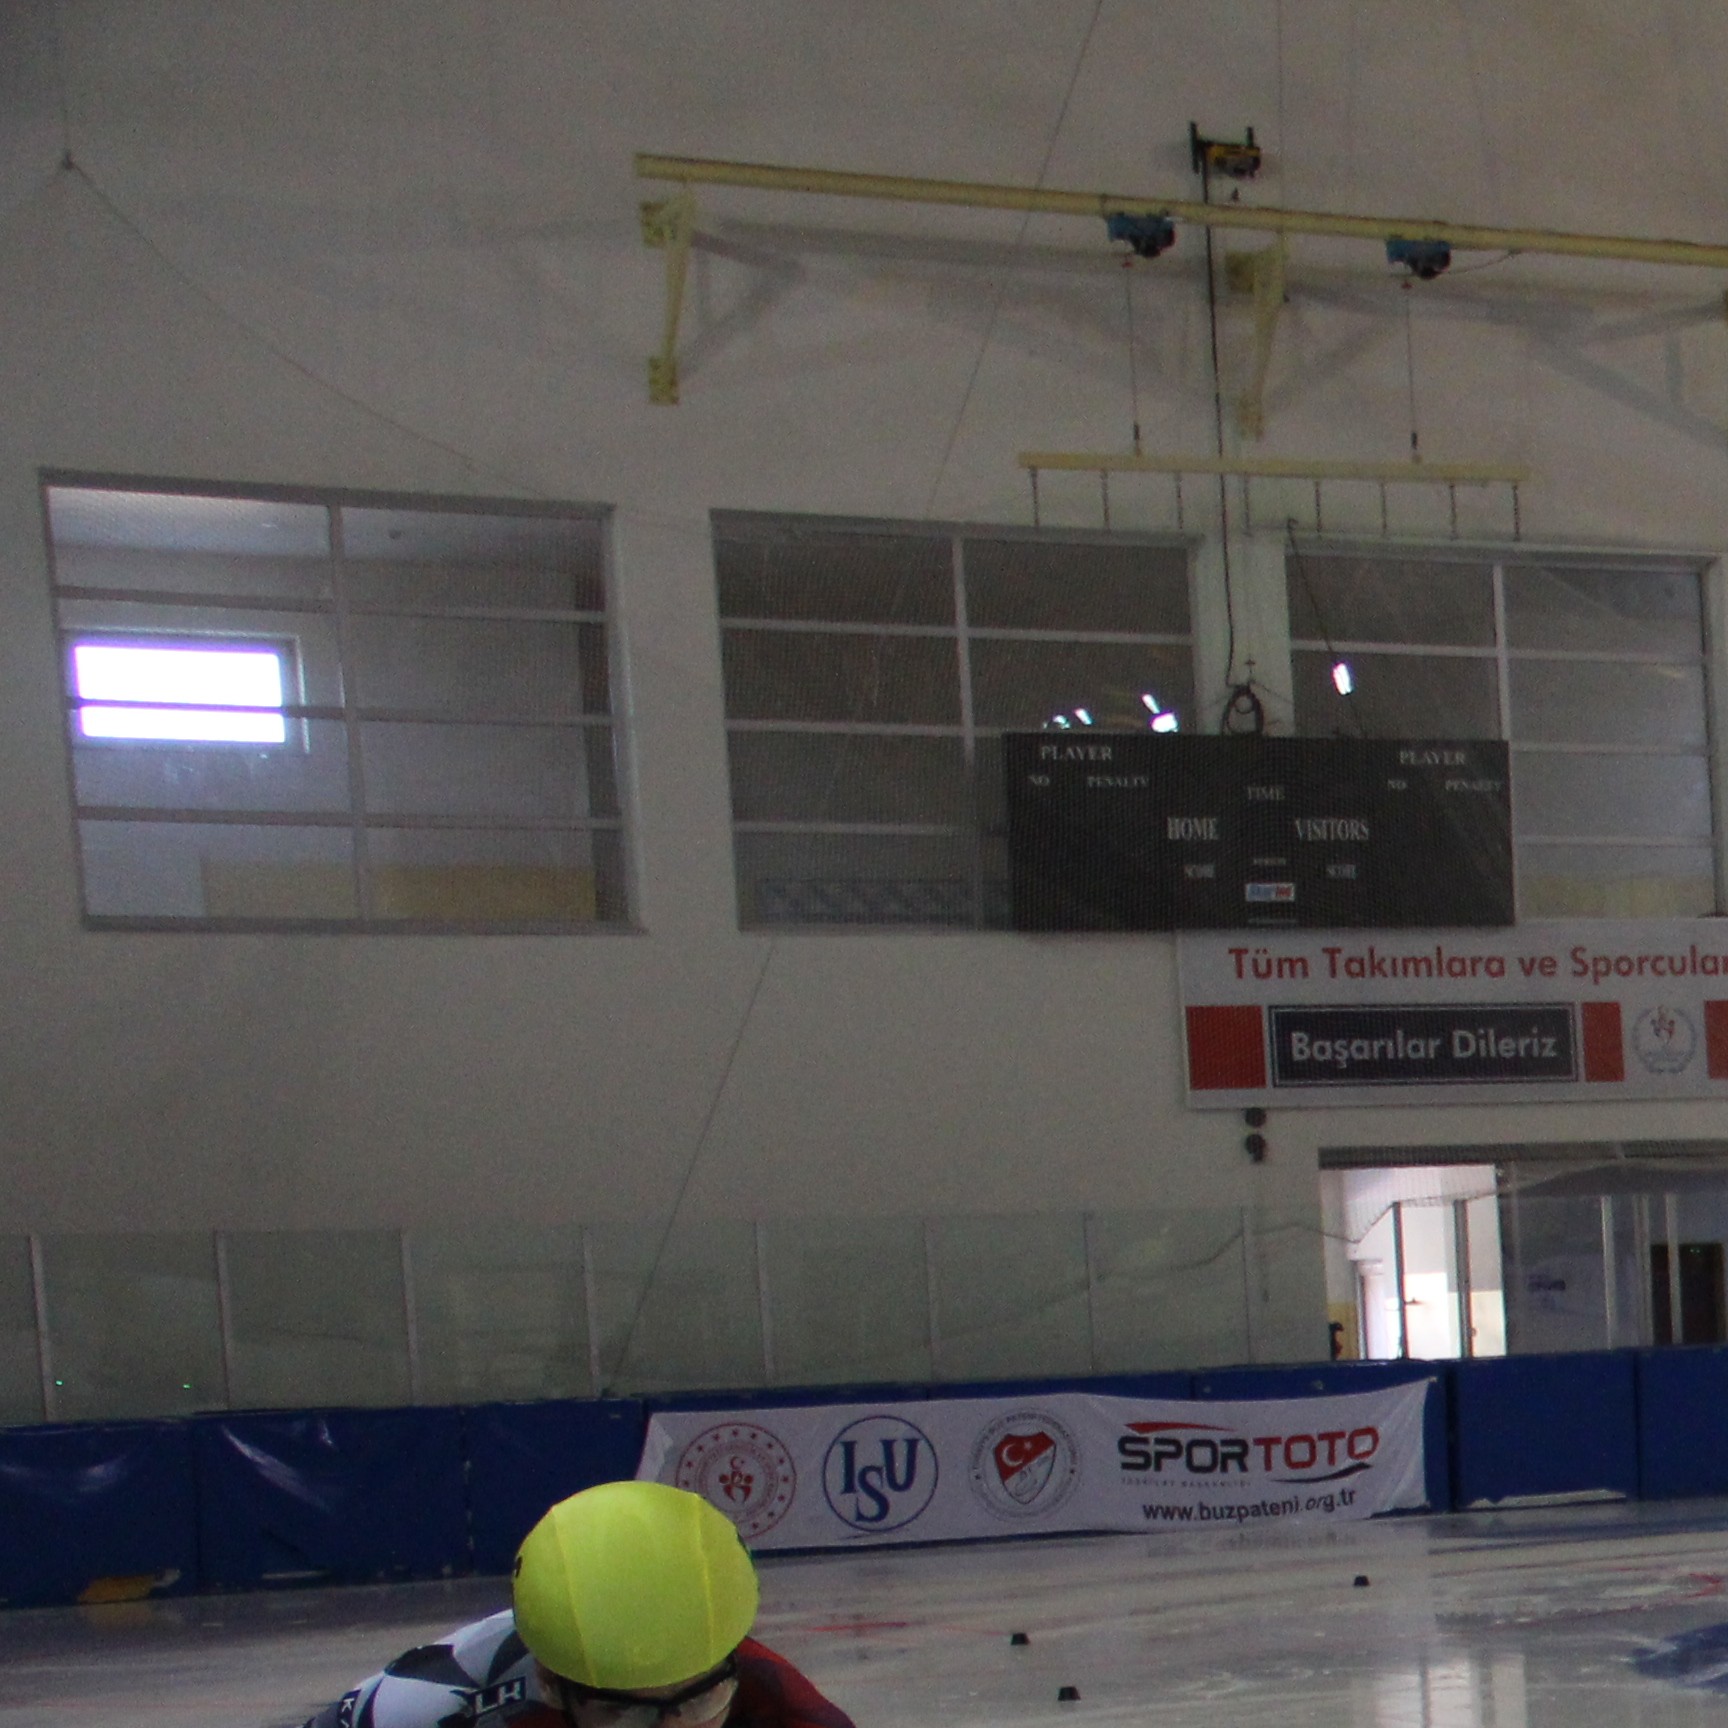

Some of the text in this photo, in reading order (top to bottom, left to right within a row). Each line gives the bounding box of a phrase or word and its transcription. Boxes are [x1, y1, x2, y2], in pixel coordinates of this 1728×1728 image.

[1041, 745, 1113, 761] PLAYER
[1399, 750, 1466, 766] PLAYER
[1028, 774, 1149, 788] NO PENALTY
[1247, 785, 1285, 801] TIME
[1387, 779, 1408, 791] NO
[1166, 816, 1219, 841] HOME
[1294, 816, 1370, 841] VISITORS
[1228, 946, 1310, 981] Tüm
[1321, 946, 1507, 980] Takımlara
[1518, 953, 1558, 978] ve
[1290, 1027, 1558, 1070] Başarılar Dileriz
[840, 1437, 919, 1523] ISU
[1142, 1488, 1356, 1523] www.buzpateni.org.tr
